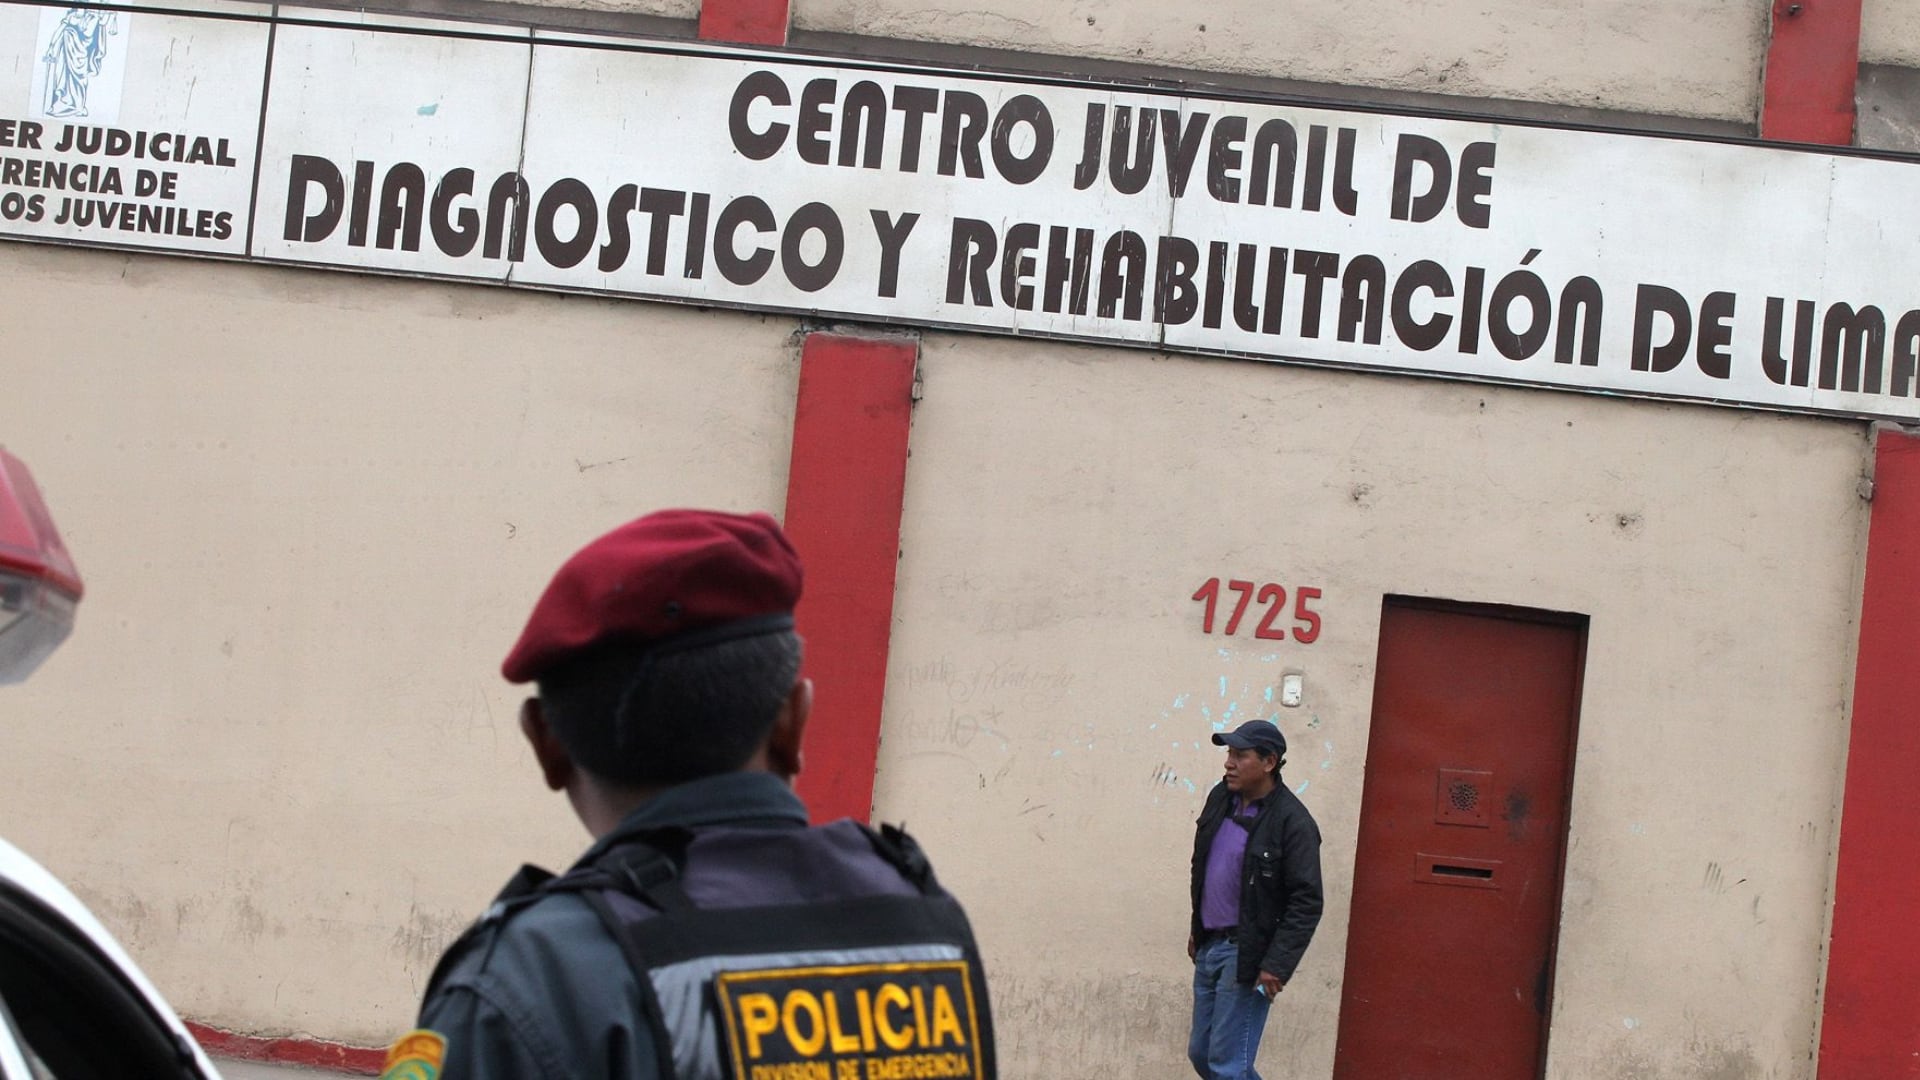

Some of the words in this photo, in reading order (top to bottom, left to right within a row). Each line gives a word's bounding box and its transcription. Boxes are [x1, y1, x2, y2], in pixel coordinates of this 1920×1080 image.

[54, 124, 237, 168] JUDICIAL
[728, 70, 1055, 185] CENTRO
[1073, 102, 1358, 217] JUVENIL
[1390, 133, 1497, 229] DE
[0, 156, 122, 195] RENCIA
[134, 169, 178, 200] DE
[0, 192, 45, 222] OS
[54, 197, 233, 241] JUVENILES
[283, 154, 845, 293] DIAGNOSTICO
[869, 209, 921, 298] Y
[945, 217, 1603, 367] REHABILITACIÓN
[1630, 283, 1736, 380] DE
[1761, 296, 1920, 399] LIMA
[1192, 577, 1323, 644] 1725
[737, 982, 967, 1059] POLICIA
[751, 1060, 832, 1080] DIVISION
[836, 1058, 860, 1080] DE
[866, 1052, 971, 1080] EMERGENCIA
